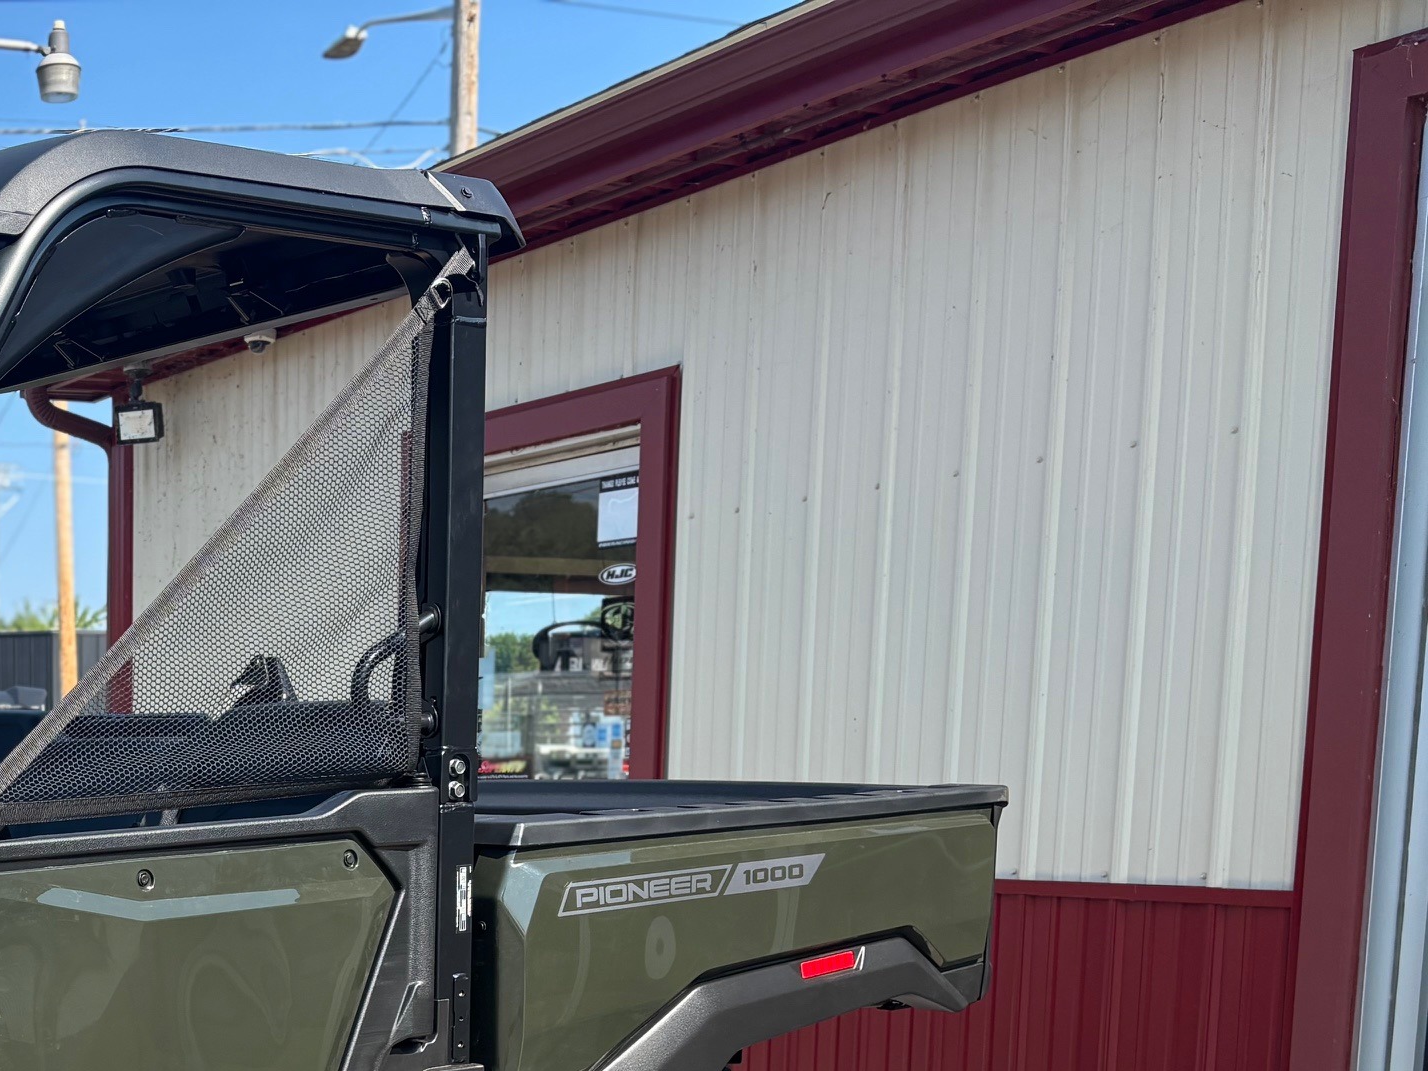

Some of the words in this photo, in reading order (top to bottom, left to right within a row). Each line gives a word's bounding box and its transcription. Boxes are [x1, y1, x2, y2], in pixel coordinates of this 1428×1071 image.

[605, 567, 634, 581] HJC
[575, 873, 712, 908] PIONEER
[742, 863, 804, 886] 1000
